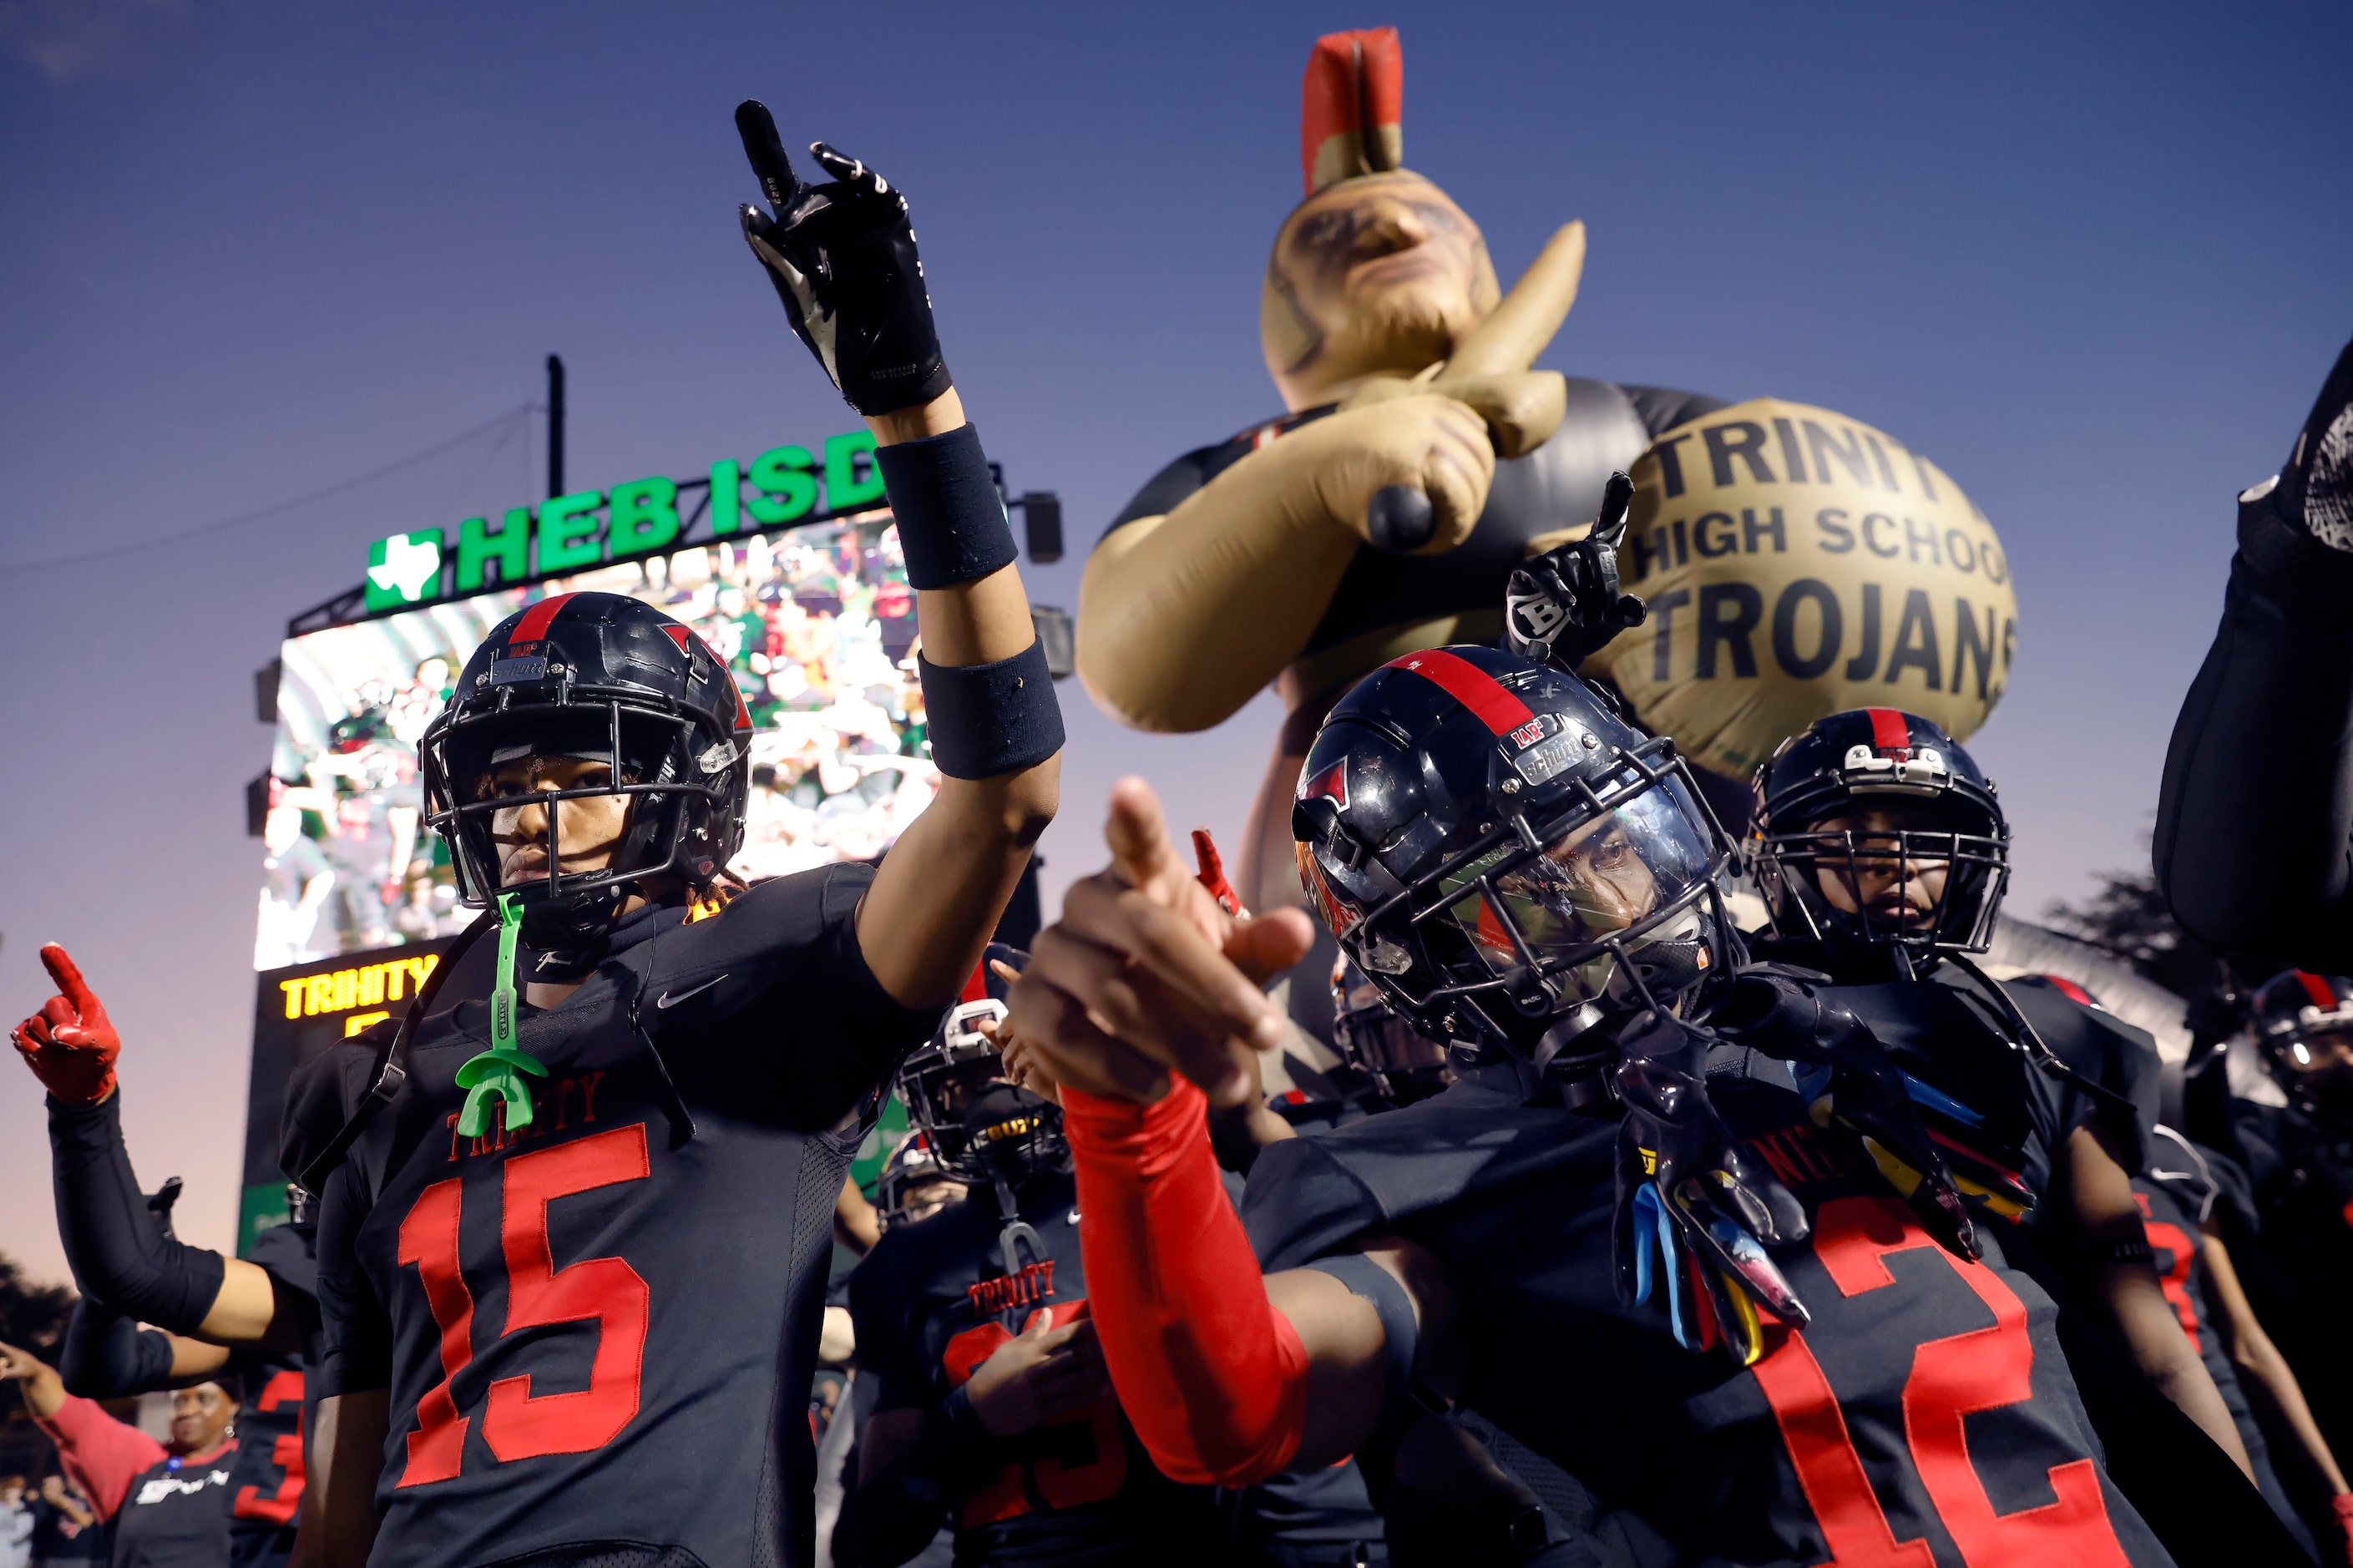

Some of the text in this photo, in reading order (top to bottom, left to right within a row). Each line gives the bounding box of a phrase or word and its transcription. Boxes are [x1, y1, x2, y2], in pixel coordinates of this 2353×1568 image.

[457, 429, 888, 590] HEB ISD
[1629, 506, 1788, 580] HIGH
[1524, 738, 1579, 777] schutt
[279, 953, 440, 1019] TRINITY
[394, 1121, 651, 1490] 15
[966, 1259, 1055, 1318] TRINITY
[1752, 1195, 2131, 1568] 12
